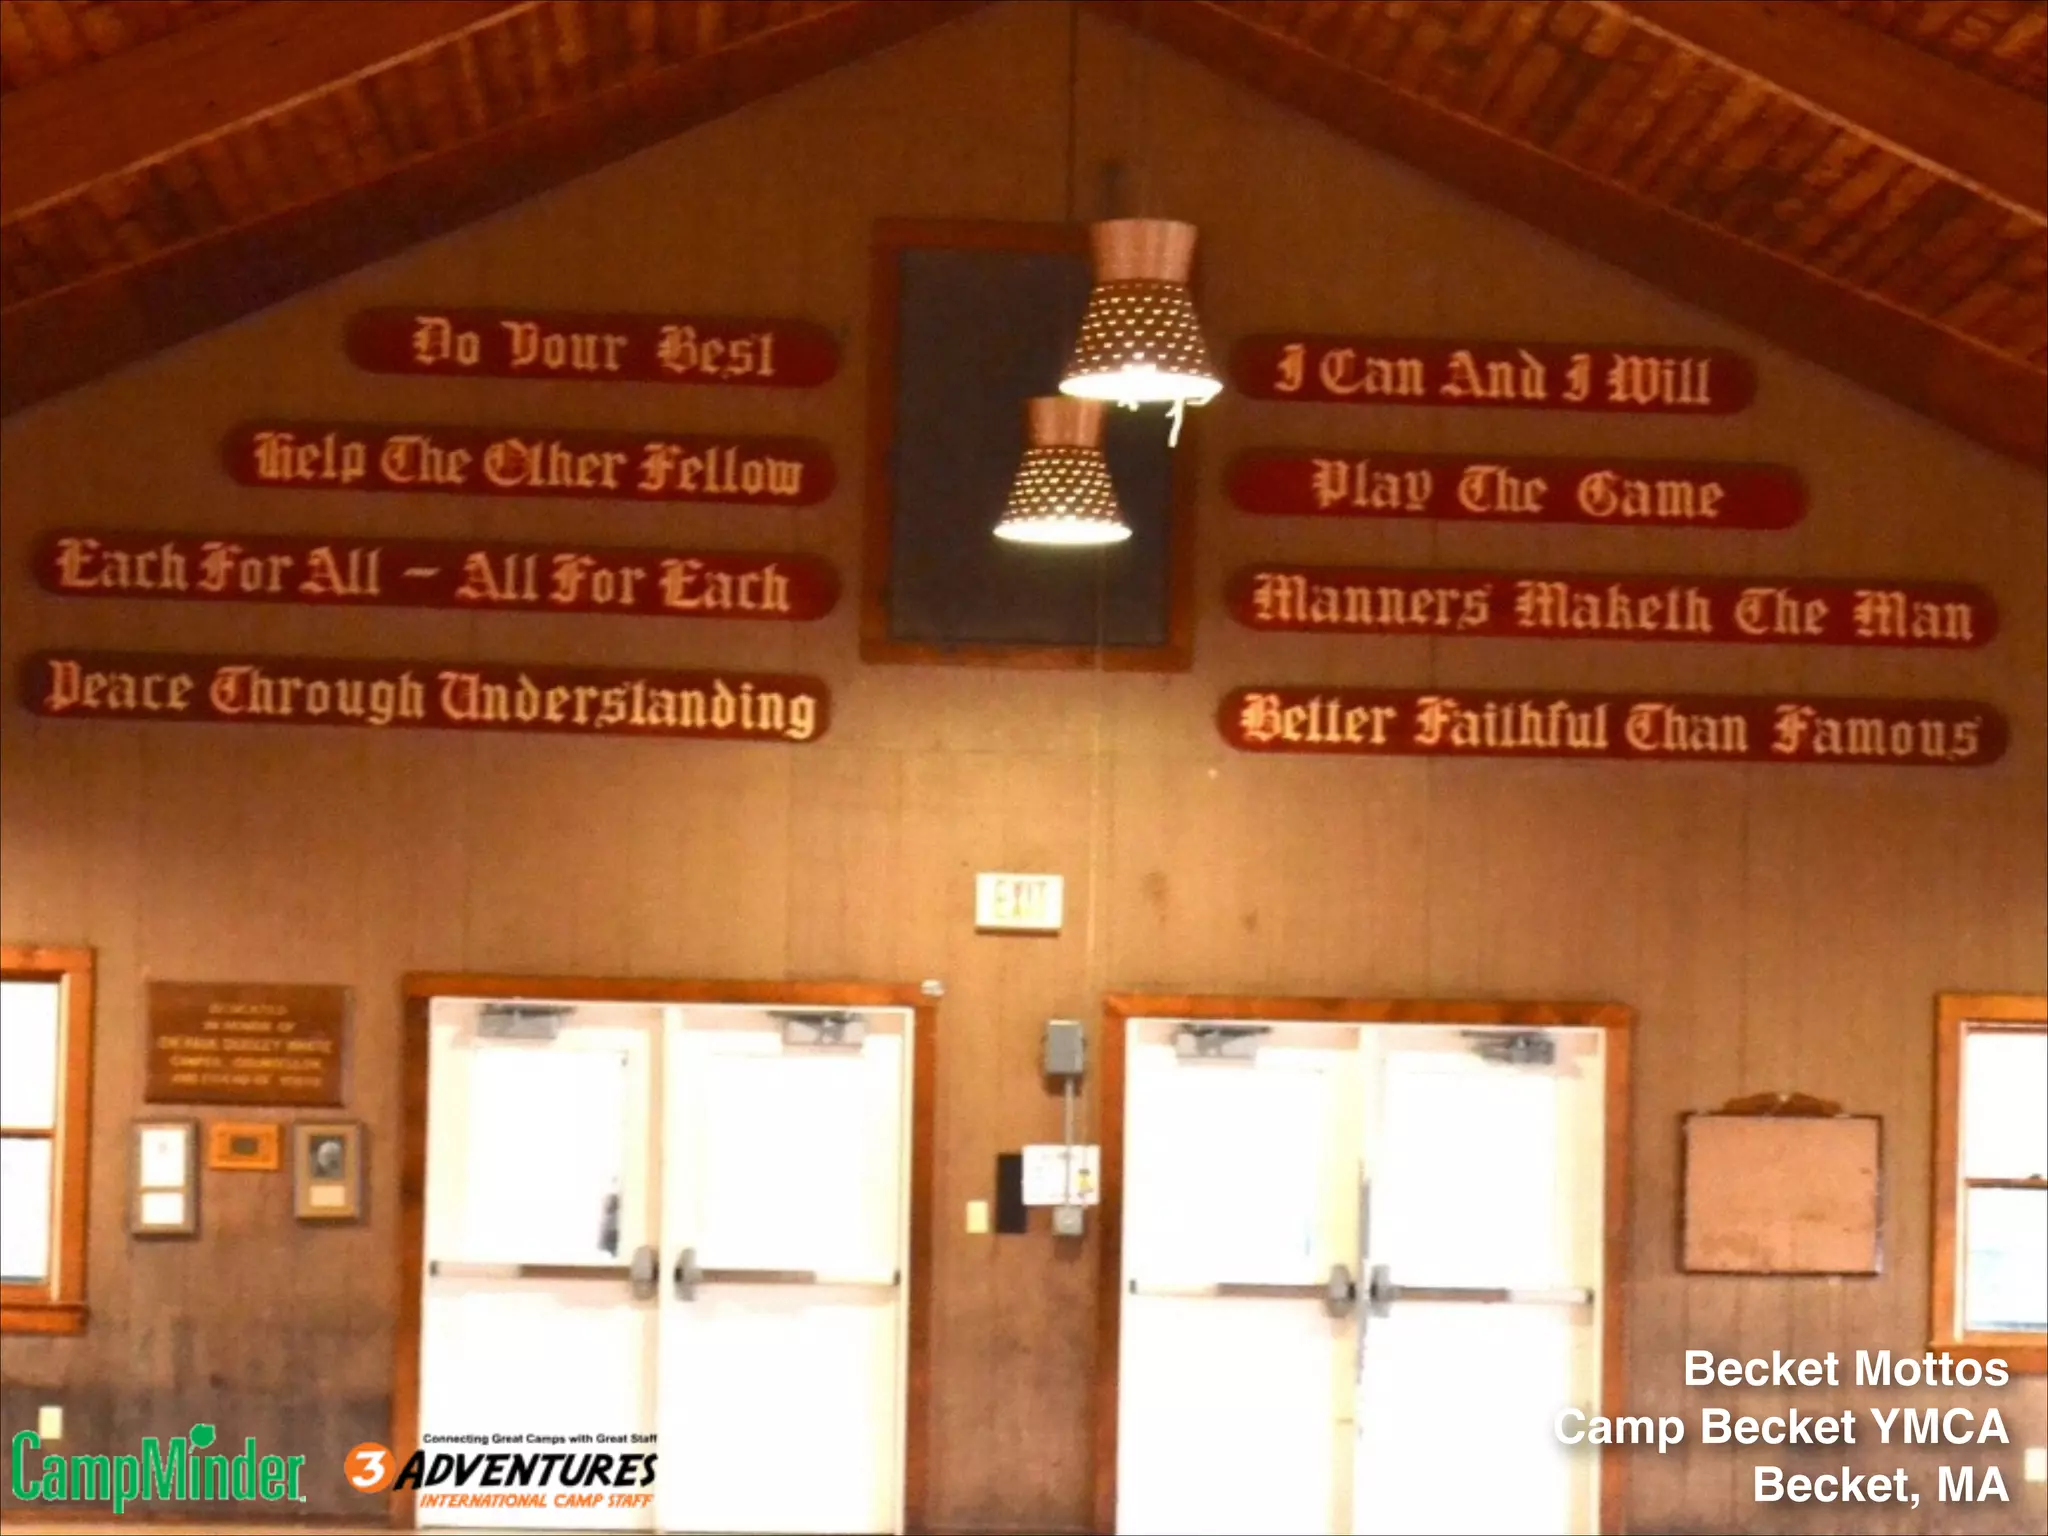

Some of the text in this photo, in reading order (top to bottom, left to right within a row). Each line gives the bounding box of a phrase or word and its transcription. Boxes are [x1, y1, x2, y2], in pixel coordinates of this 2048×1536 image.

[412, 317, 777, 378] Do Your Best
[1275, 344, 1711, 405] I Can And I Will
[253, 431, 805, 496] Help The Other Fellow
[1312, 459, 1725, 519] Play The Game
[56, 538, 187, 591] Each
[199, 542, 294, 593] For
[299, 547, 381, 596] All
[455, 550, 539, 602] All
[551, 554, 647, 605] For
[658, 559, 791, 612] Each
[1253, 573, 1974, 643] Manners Maketh The Man
[45, 660, 817, 741] Peace Through Understanding
[1241, 693, 1982, 762] Better Faithful Than Famous
[994, 878, 1047, 918] EXIT
